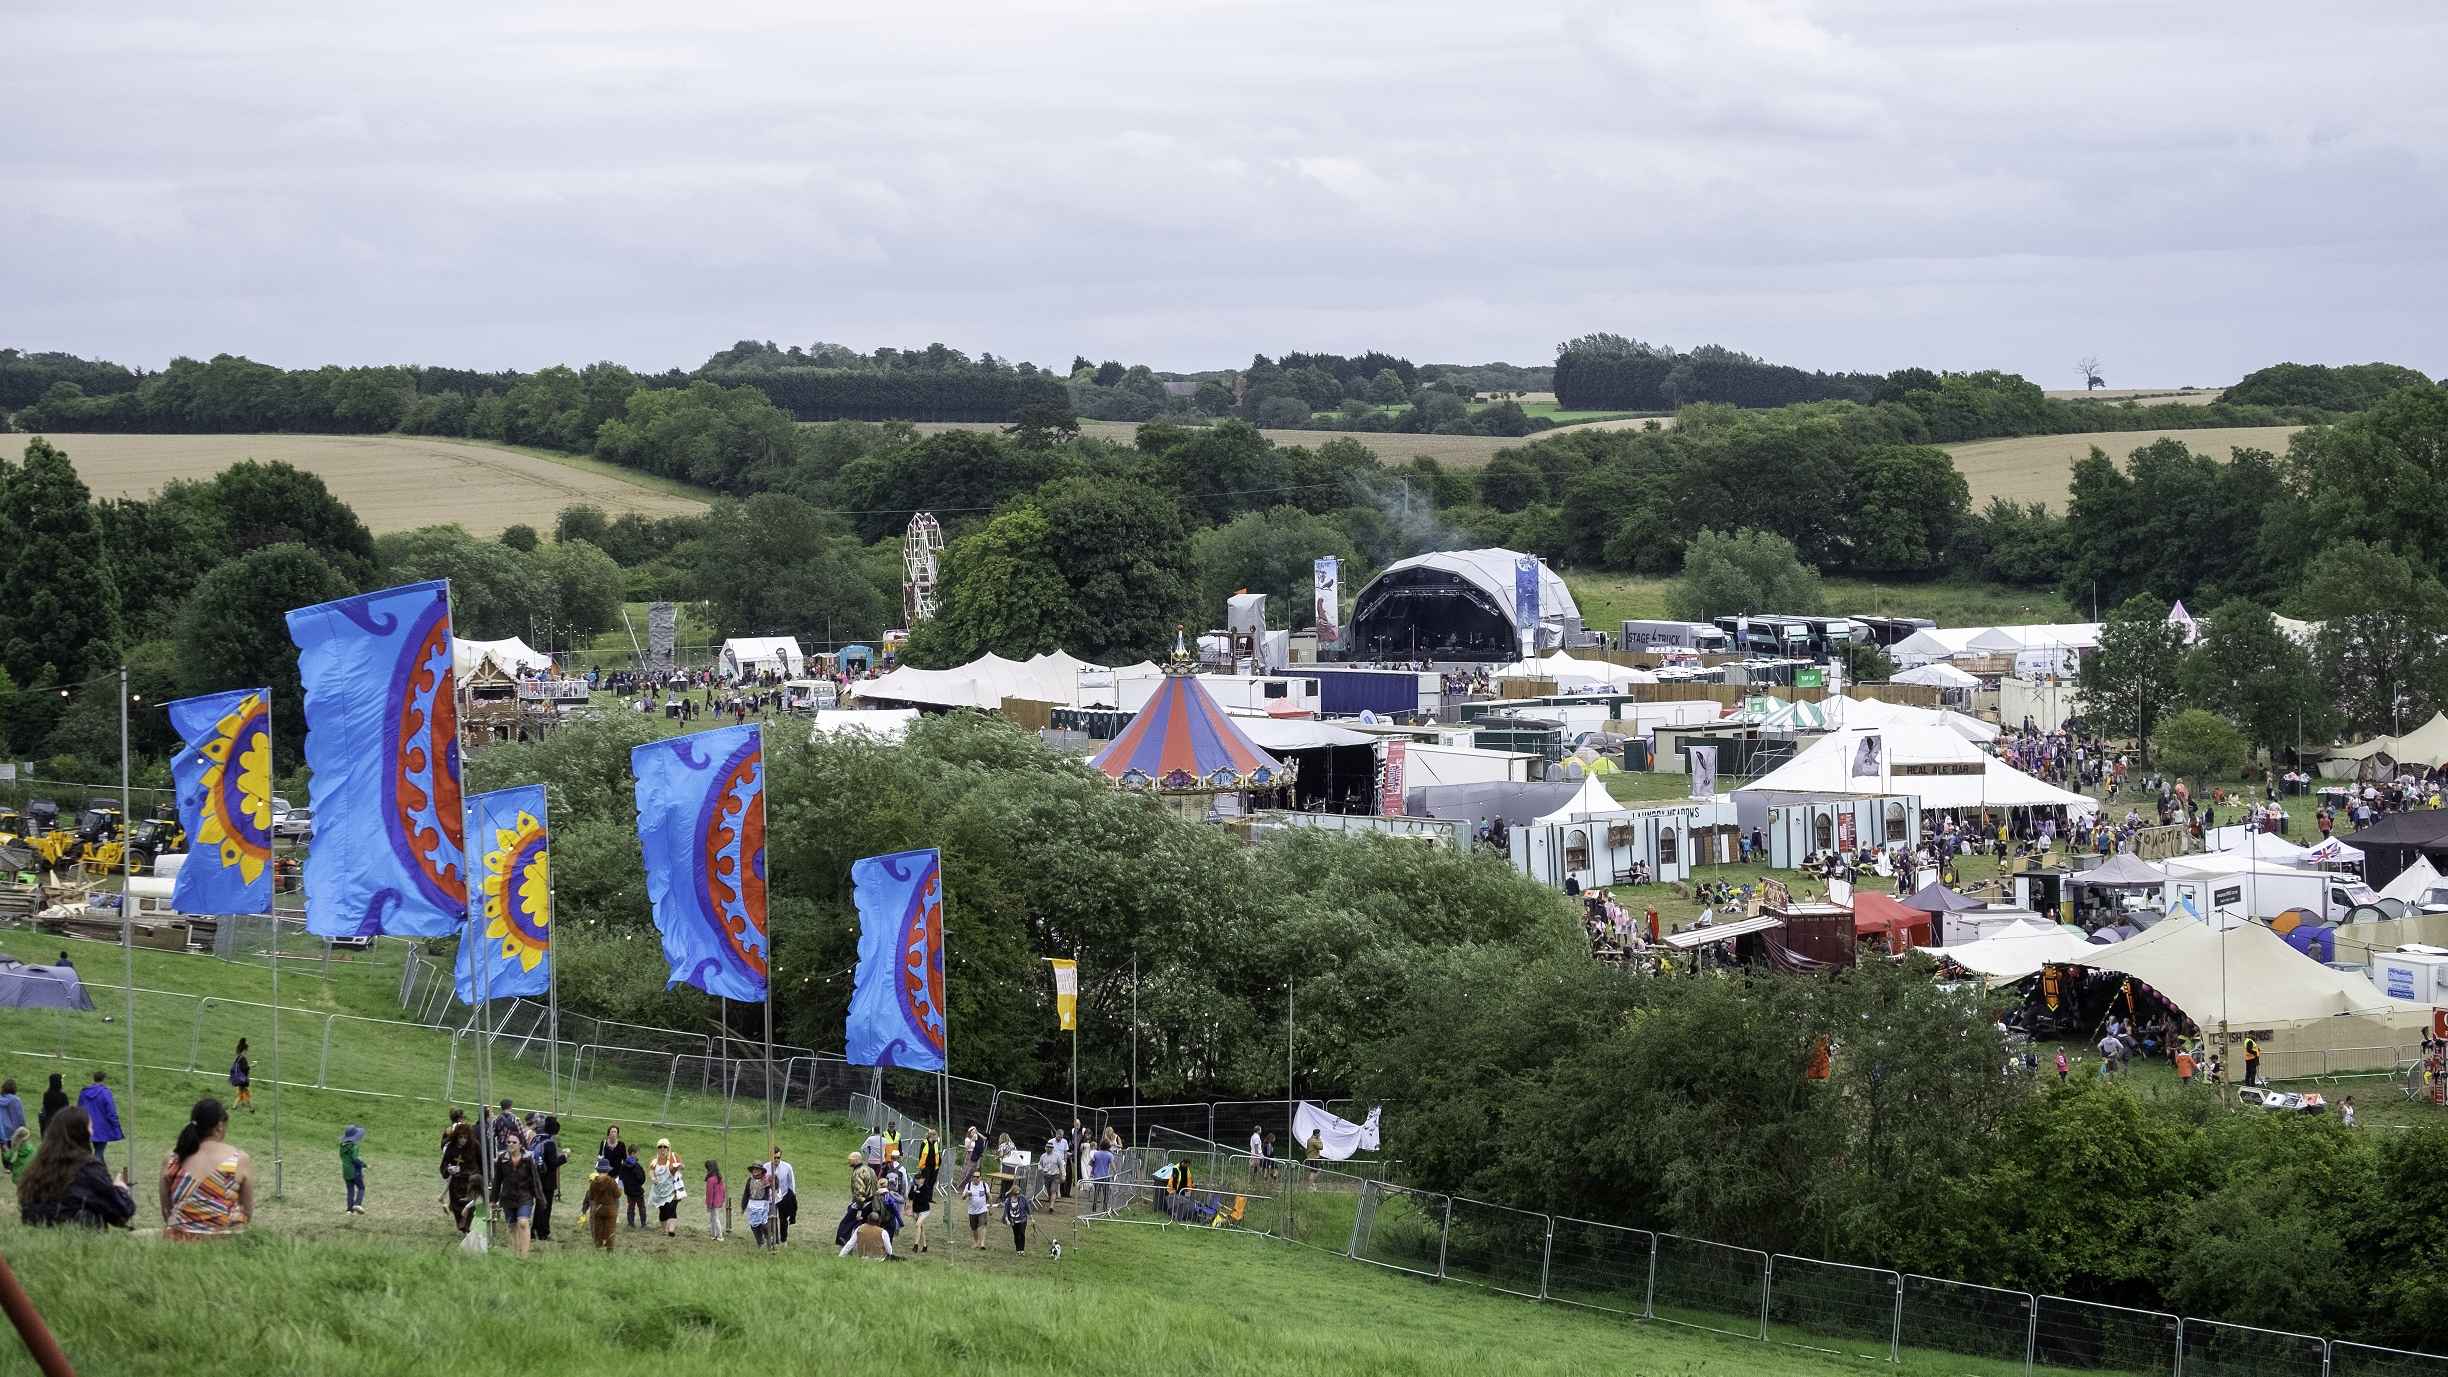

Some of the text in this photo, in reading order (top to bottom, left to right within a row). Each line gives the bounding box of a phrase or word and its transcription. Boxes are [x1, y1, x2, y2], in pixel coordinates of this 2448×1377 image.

[1628, 632, 1680, 646] STAGE TRUCK
[1952, 765, 1969, 775] BAR
